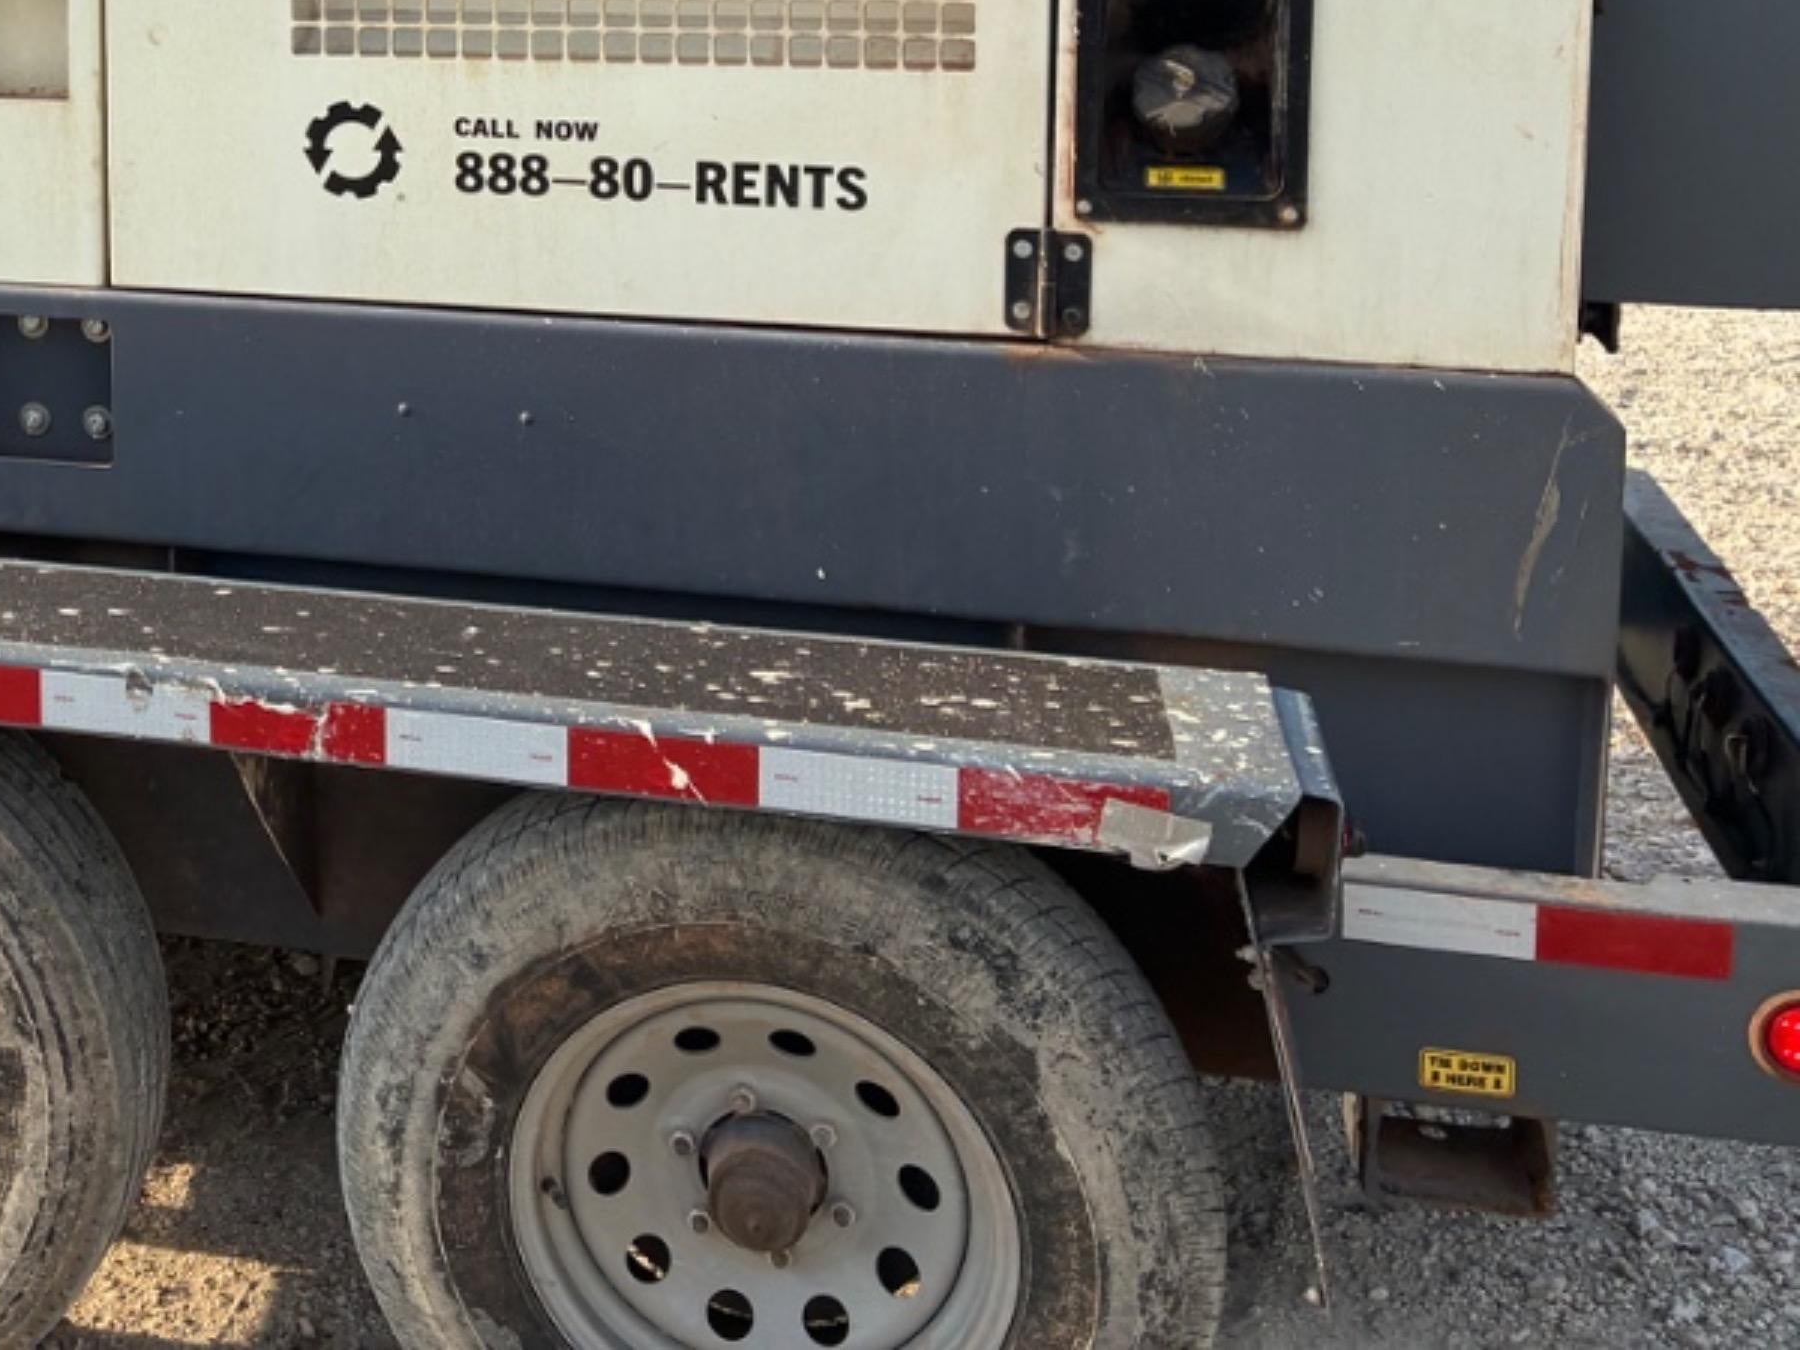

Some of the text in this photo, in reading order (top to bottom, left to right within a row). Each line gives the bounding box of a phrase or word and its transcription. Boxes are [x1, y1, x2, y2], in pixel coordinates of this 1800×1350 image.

[453, 117, 599, 142] CALL NOW
[454, 151, 868, 211] 888-80-RENTS
